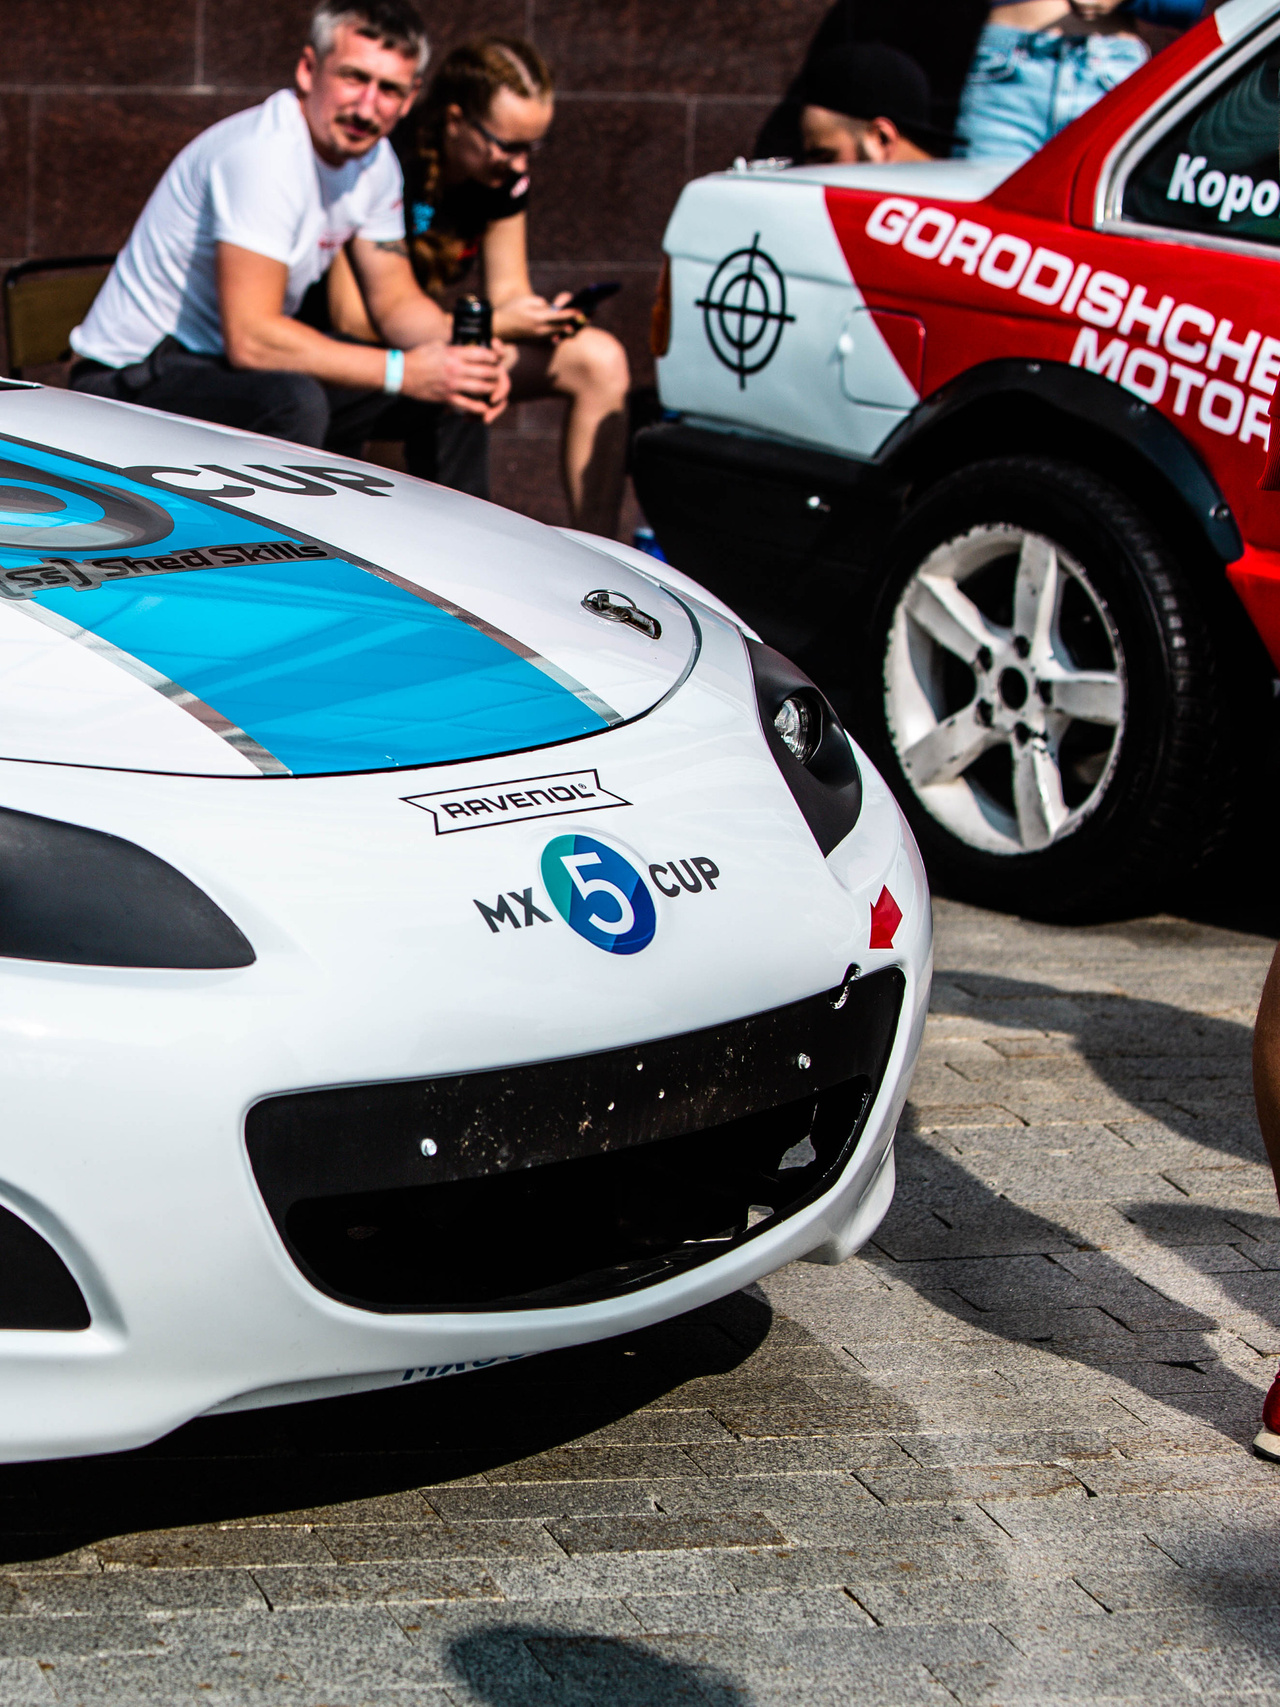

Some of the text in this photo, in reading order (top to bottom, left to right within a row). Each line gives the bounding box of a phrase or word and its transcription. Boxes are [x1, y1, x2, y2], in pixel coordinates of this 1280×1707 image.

[1166, 153, 1280, 222] Коро
[122, 464, 395, 499] CUP
[91, 552, 214, 578] Shed
[216, 543, 328, 564] Skills
[440, 785, 596, 818] RAVENOL
[473, 852, 720, 936] MX 5 CUP
